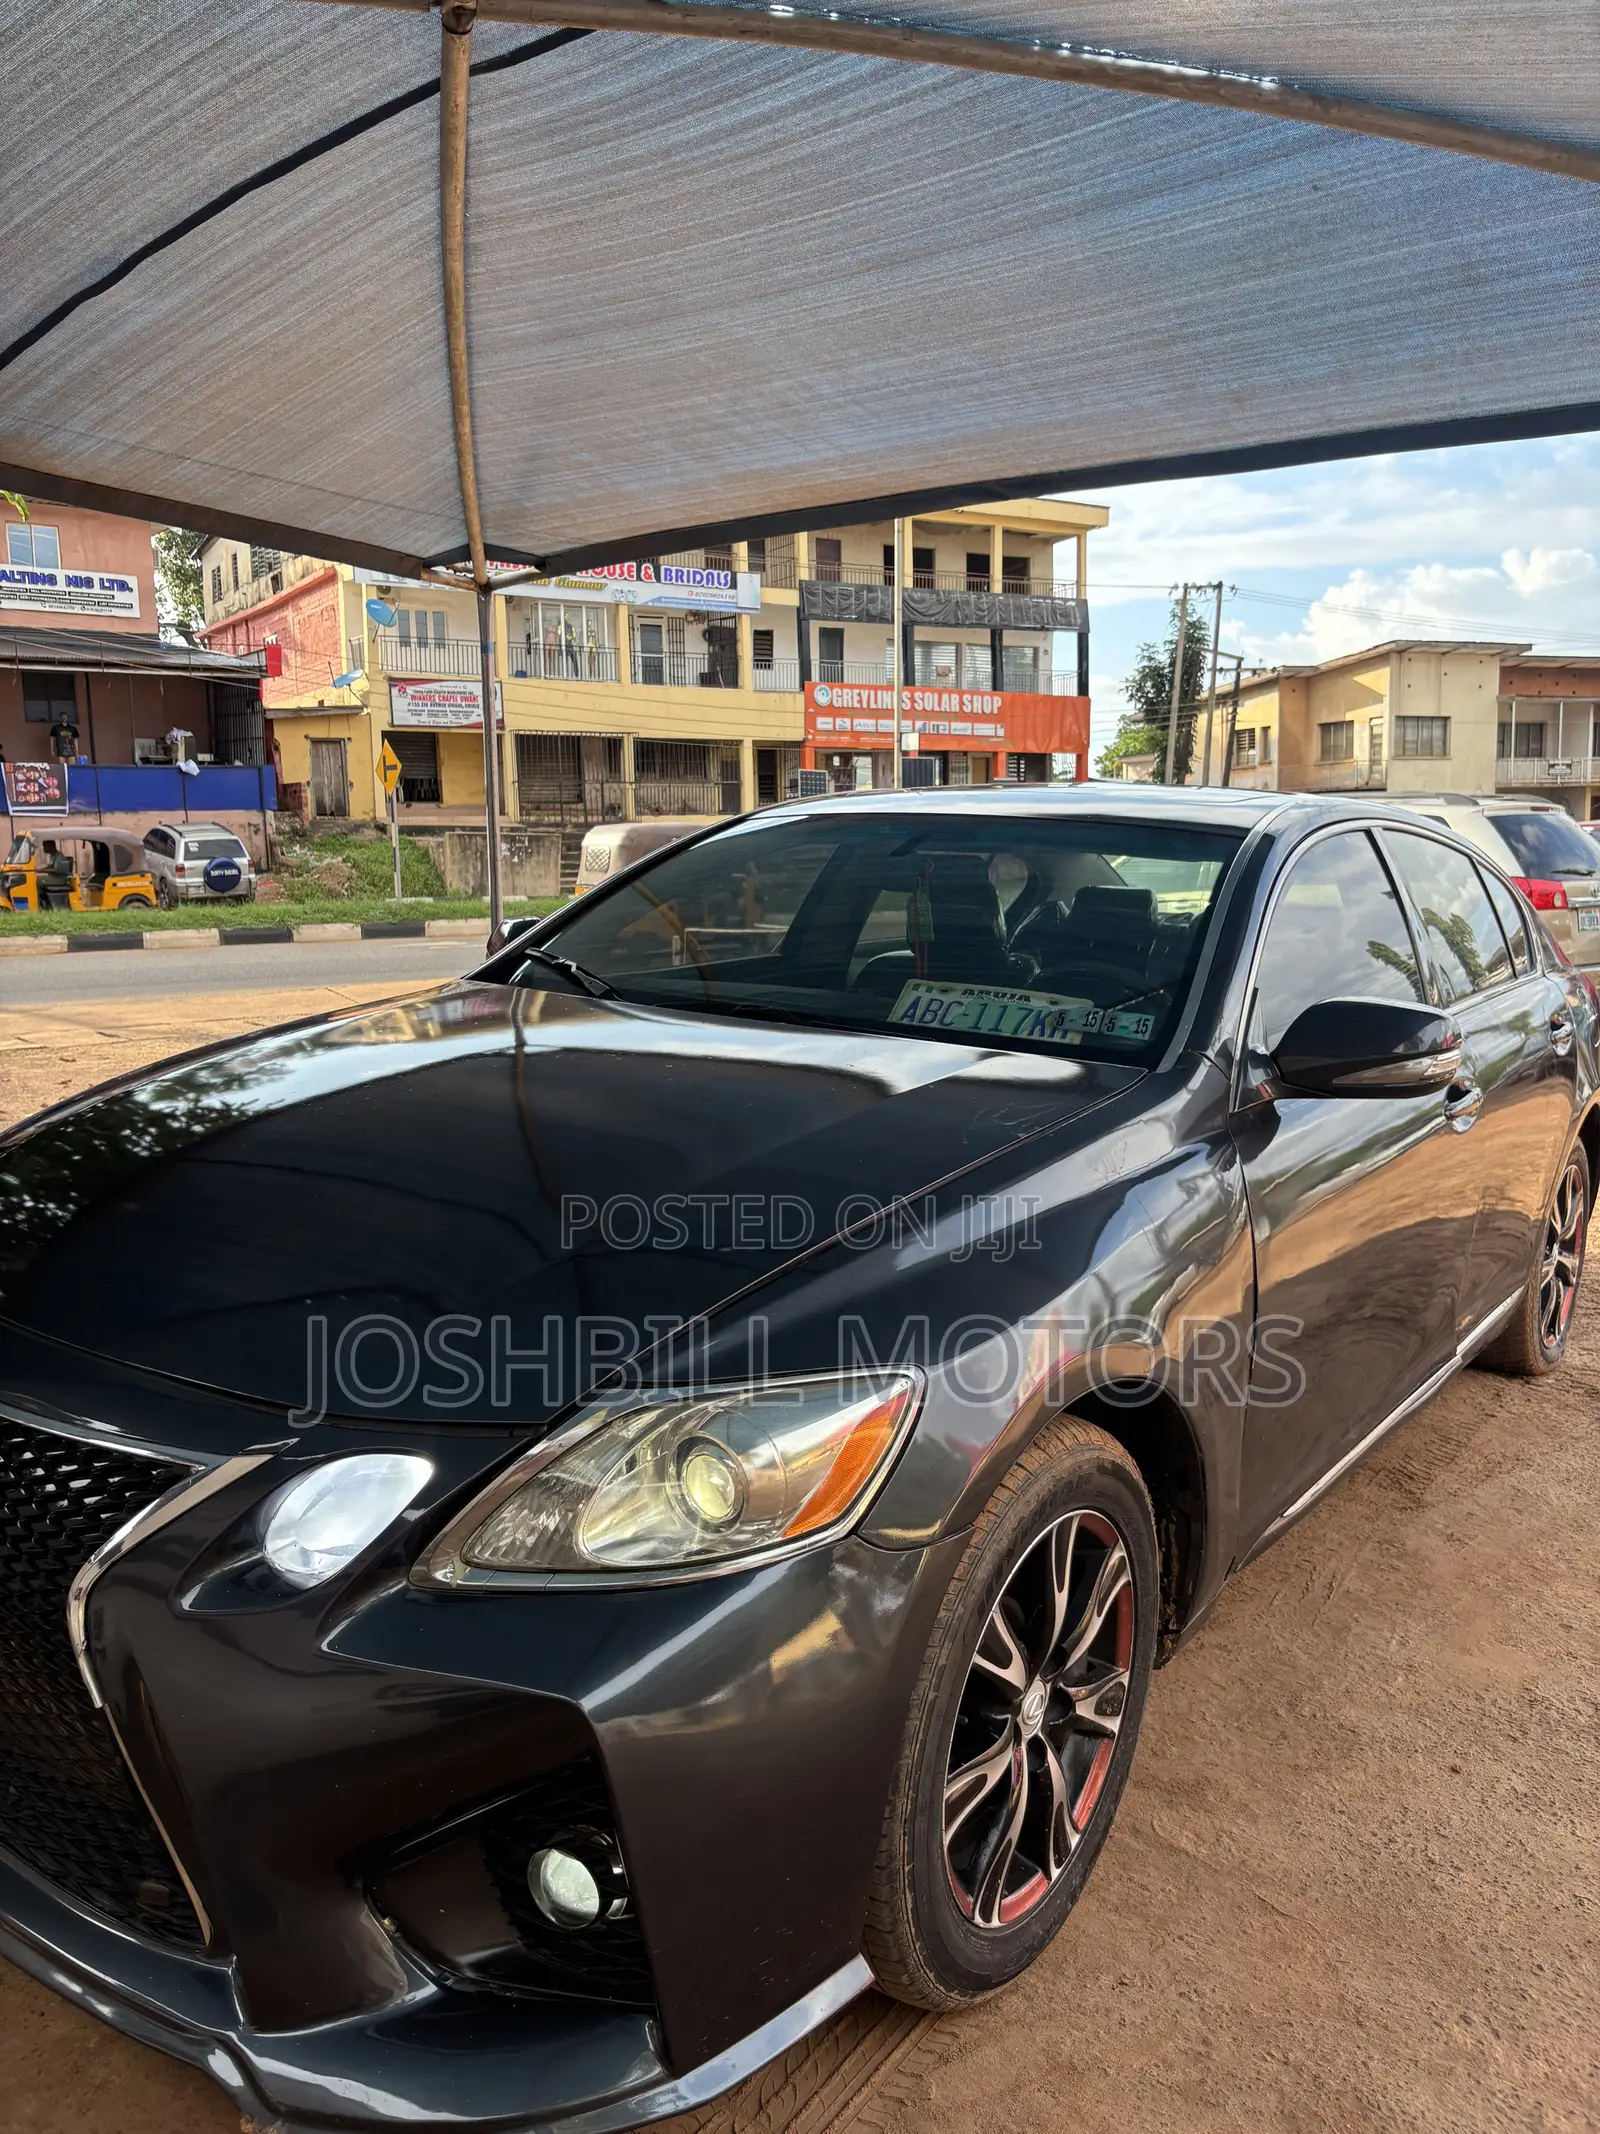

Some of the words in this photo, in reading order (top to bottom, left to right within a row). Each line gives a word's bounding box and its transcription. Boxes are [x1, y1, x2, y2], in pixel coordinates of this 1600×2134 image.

[65, 575, 94, 589] NIG
[99, 577, 133, 592] LTD.
[555, 576, 608, 591] Glamour
[641, 564, 655, 581] &
[663, 567, 731, 588] BRIDALS
[438, 694, 458, 703] CHAPEL
[831, 688, 911, 711] GREYLINS
[914, 691, 959, 712] SOLAR
[963, 693, 1002, 715] SHOP
[1082, 1010, 1099, 1028] 15
[1133, 1017, 1151, 1035] 15
